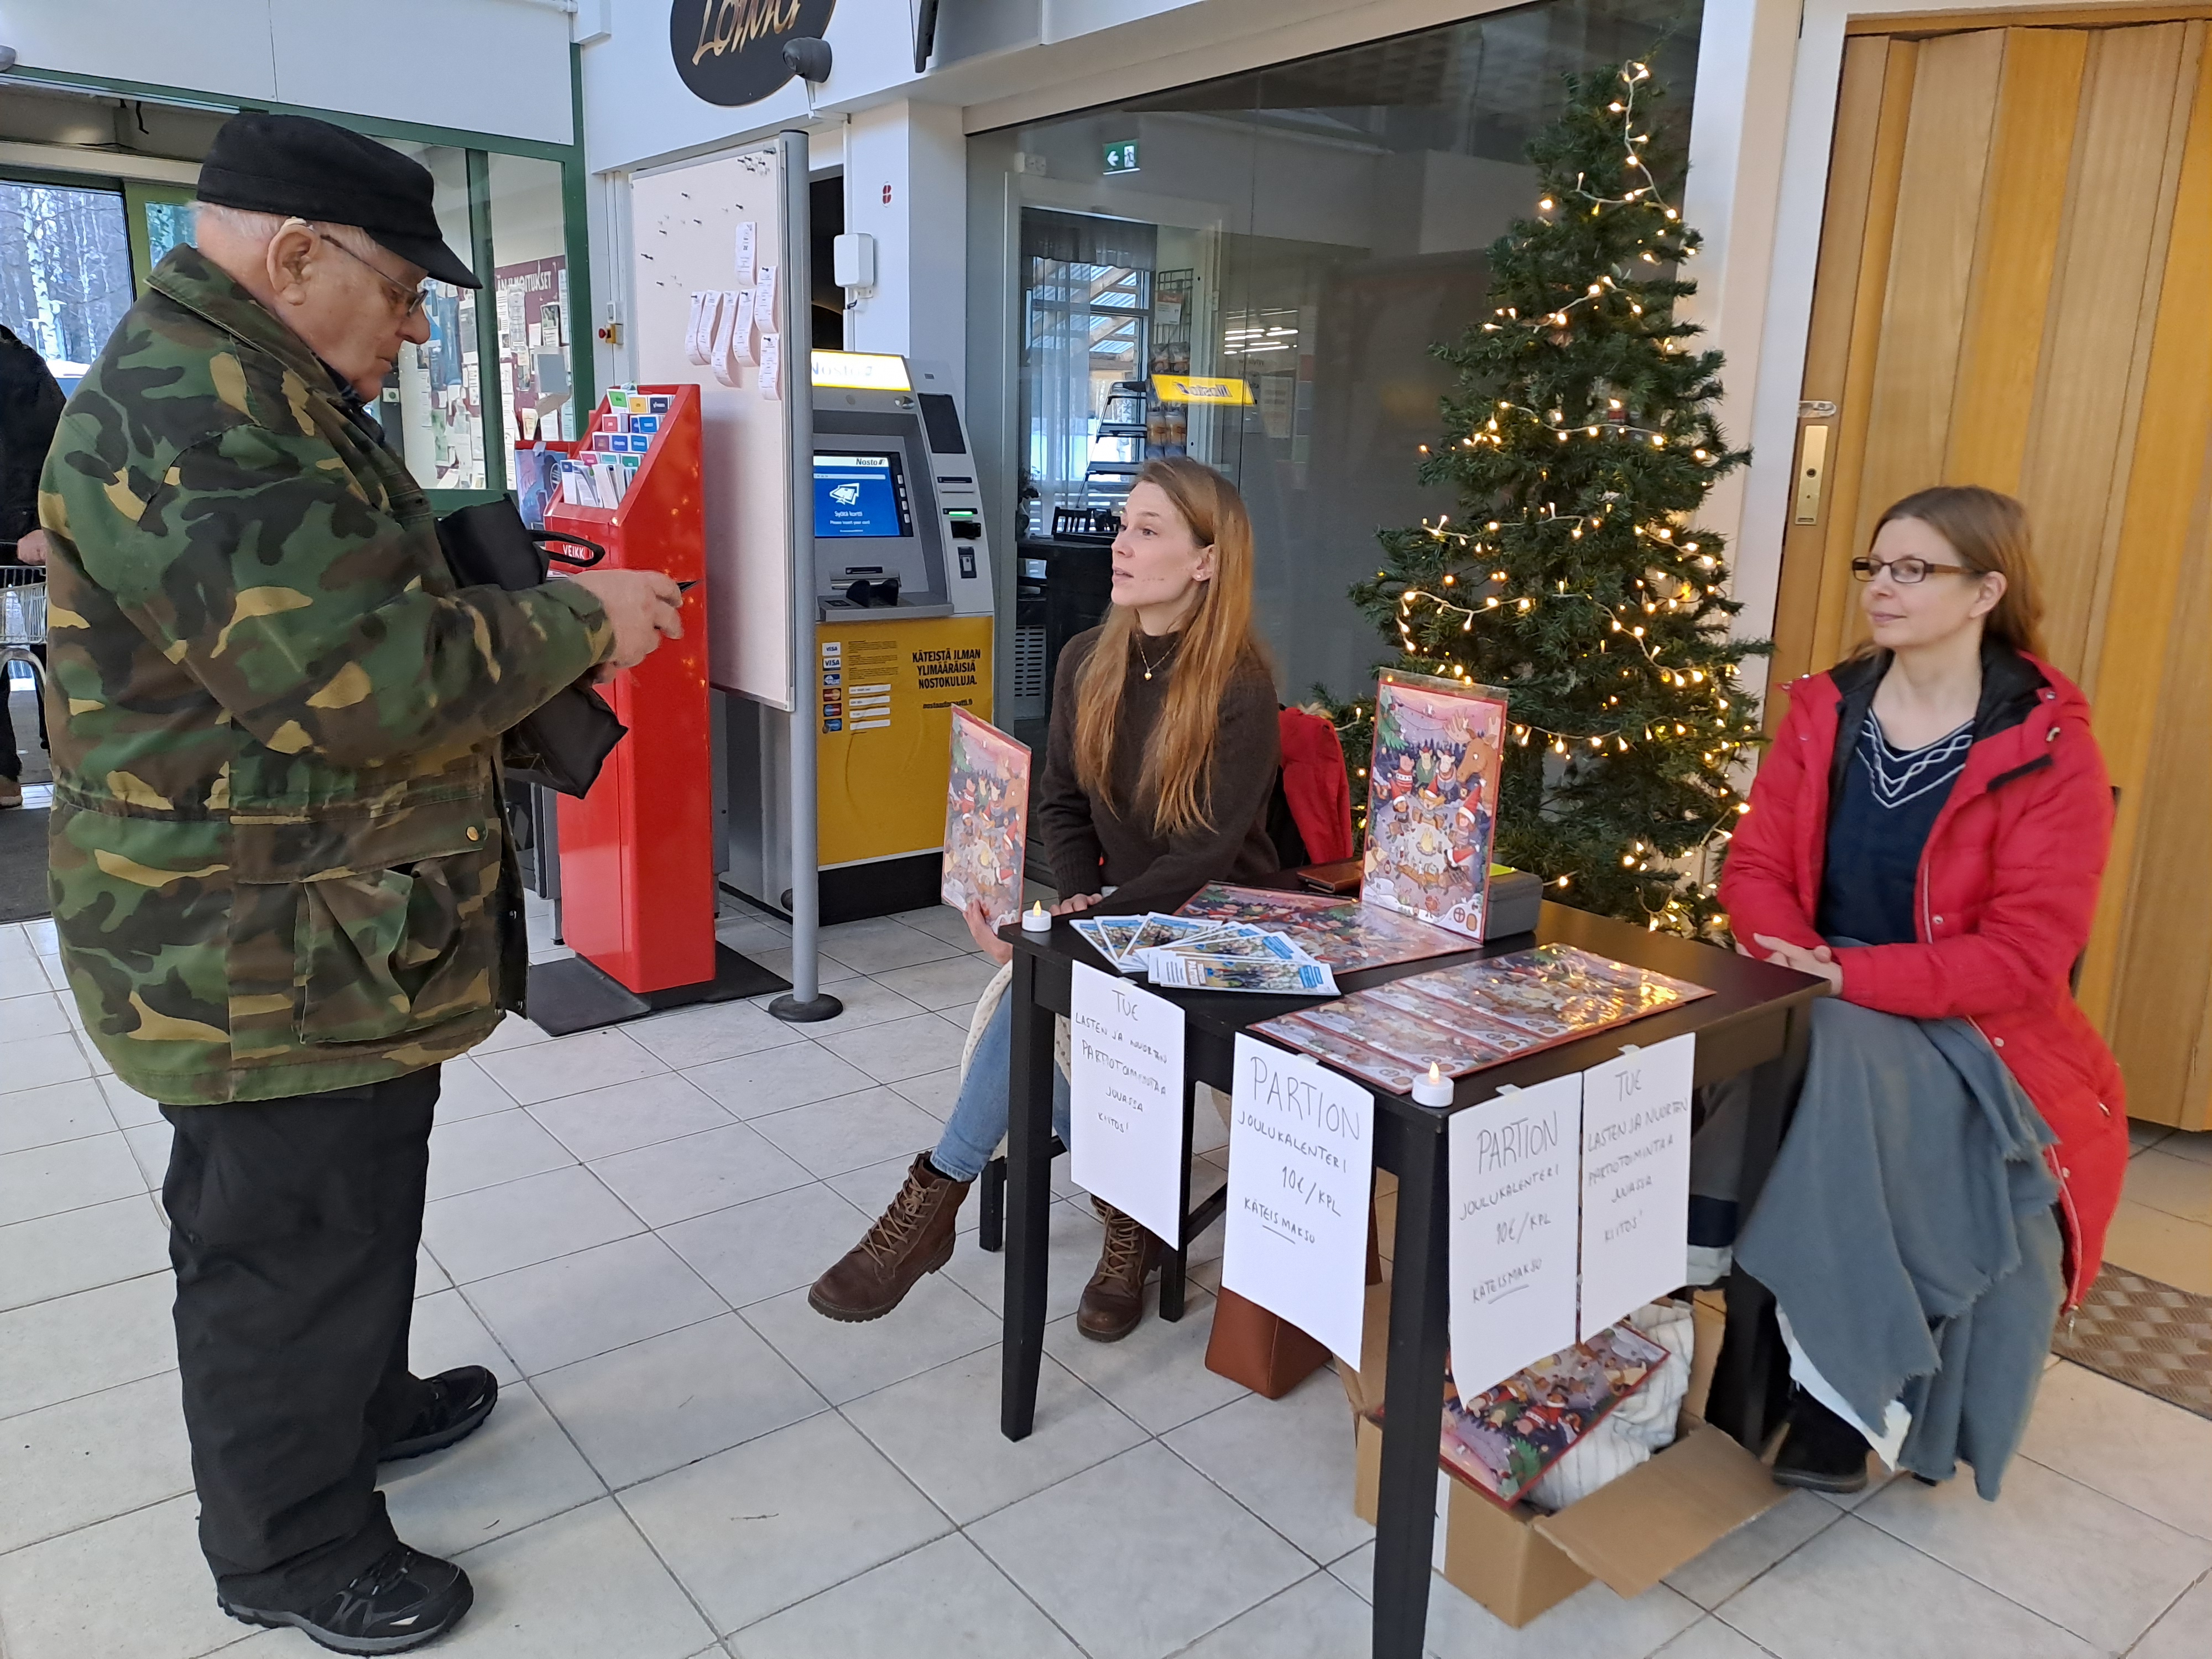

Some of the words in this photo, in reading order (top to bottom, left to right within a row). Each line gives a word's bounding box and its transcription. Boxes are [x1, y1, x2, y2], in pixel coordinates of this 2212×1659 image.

[912, 648, 951, 663] KÄTEISTÄ
[954, 648, 981, 660] ILMAN
[916, 660, 976, 676] YLIMÄÄRÄISIÄ
[918, 676, 978, 690] NOSTOKULUJA.
[1112, 989, 1139, 1021] TUE
[1076, 1012, 1108, 1035] LASTEN
[1112, 1030, 1123, 1041] JA
[1250, 1056, 1360, 1141] PARTION
[1615, 1069, 1642, 1102] TUE
[1237, 1110, 1347, 1173] JOULUKALENTERI
[1477, 1111, 1558, 1175] PARTION
[1588, 1120, 1627, 1152] LASTEN
[1628, 1113, 1642, 1134] JA
[1459, 1164, 1559, 1222] JOULUKALENTERI
